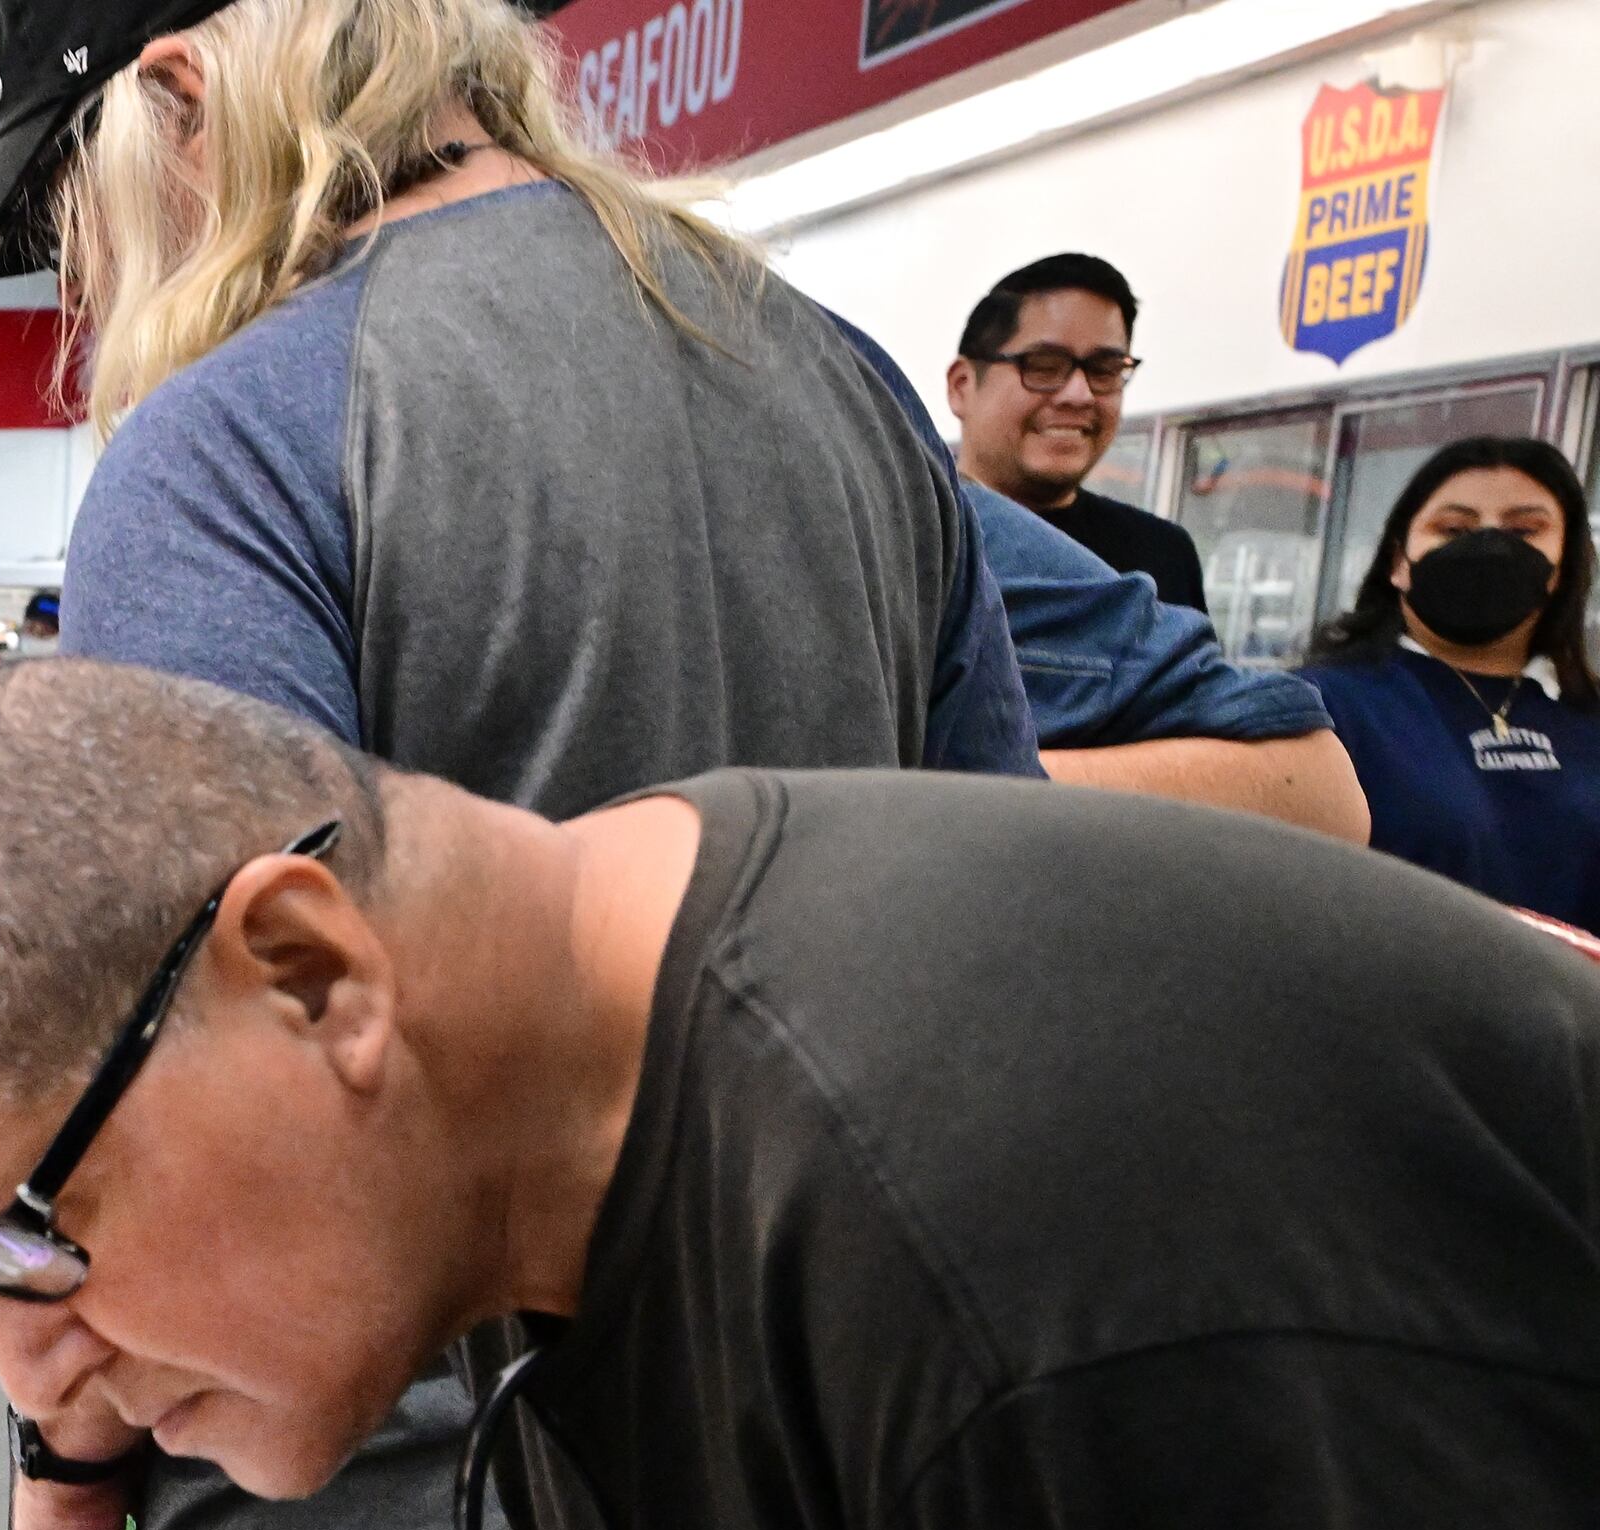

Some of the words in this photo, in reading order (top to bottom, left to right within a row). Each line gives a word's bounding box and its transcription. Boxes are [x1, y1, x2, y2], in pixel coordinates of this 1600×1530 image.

[577, 0, 744, 150] SEAFOOD
[1305, 172, 1417, 241] PRIME
[1302, 247, 1401, 327] BEEF
